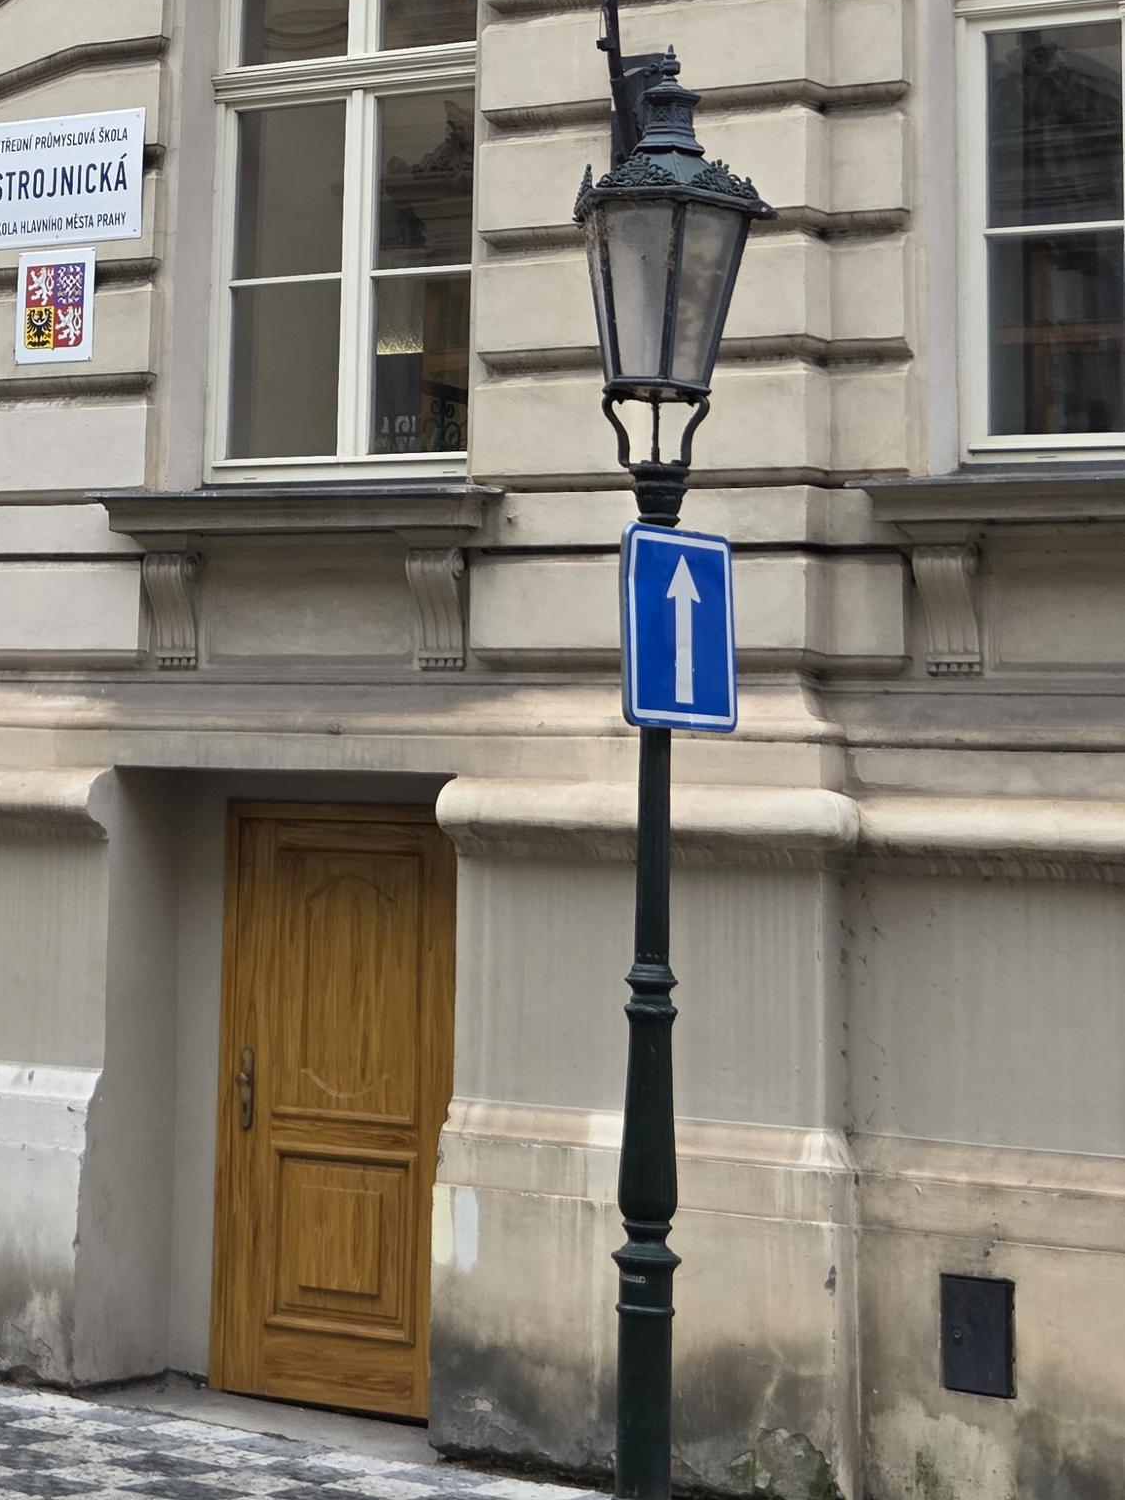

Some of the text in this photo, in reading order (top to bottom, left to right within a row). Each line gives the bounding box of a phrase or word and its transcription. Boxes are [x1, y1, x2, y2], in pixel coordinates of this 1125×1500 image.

[35, 128, 96, 150] PRŮMYSLOVÁ
[98, 127, 129, 143] ŠKOLA
[20, 215, 64, 234] HLAVNÍHO
[65, 212, 94, 231] MĚSTA
[97, 211, 127, 228] PRAHY
